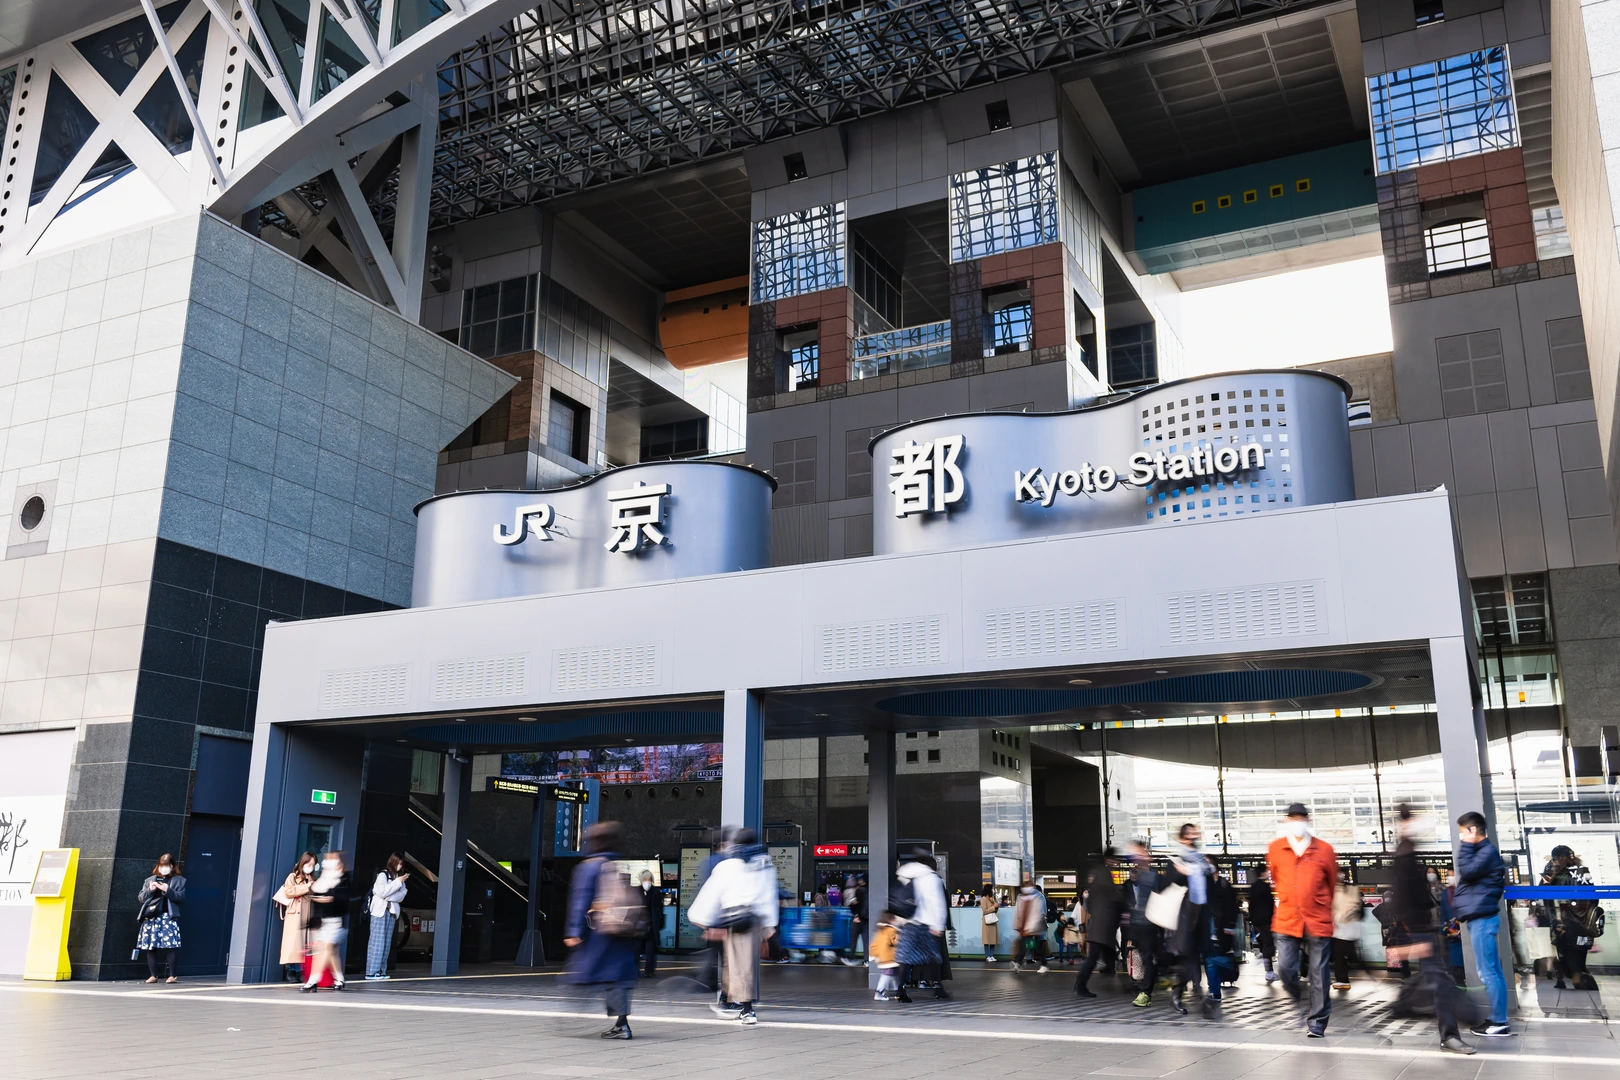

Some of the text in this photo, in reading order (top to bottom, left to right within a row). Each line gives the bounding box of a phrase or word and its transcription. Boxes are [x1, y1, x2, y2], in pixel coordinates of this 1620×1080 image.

[888, 434, 1266, 519] 都 Kyoto Station
[493, 481, 672, 554] JR 京
